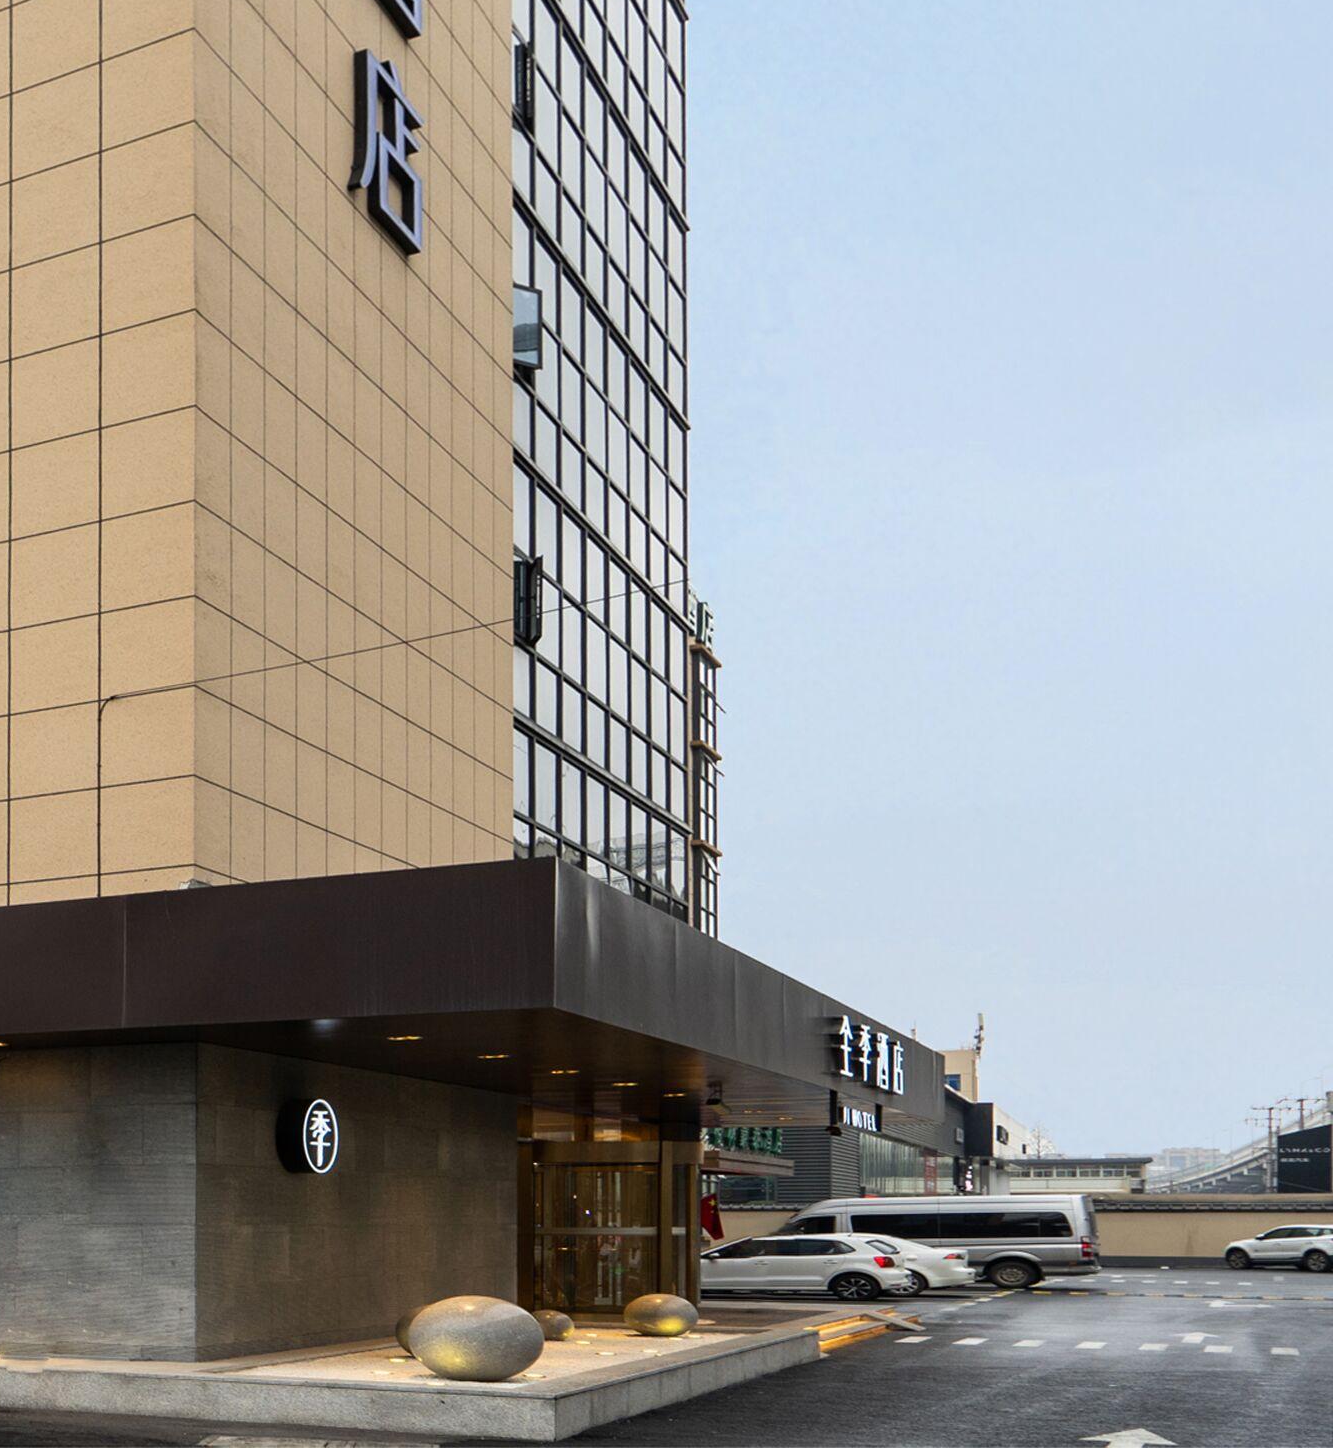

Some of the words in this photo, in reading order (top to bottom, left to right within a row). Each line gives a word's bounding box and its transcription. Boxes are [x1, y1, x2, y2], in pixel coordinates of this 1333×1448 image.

[839, 1015, 904, 1095] 全季酒店
[309, 1110, 332, 1167] 季
[851, 1108, 877, 1132] HOTEL
